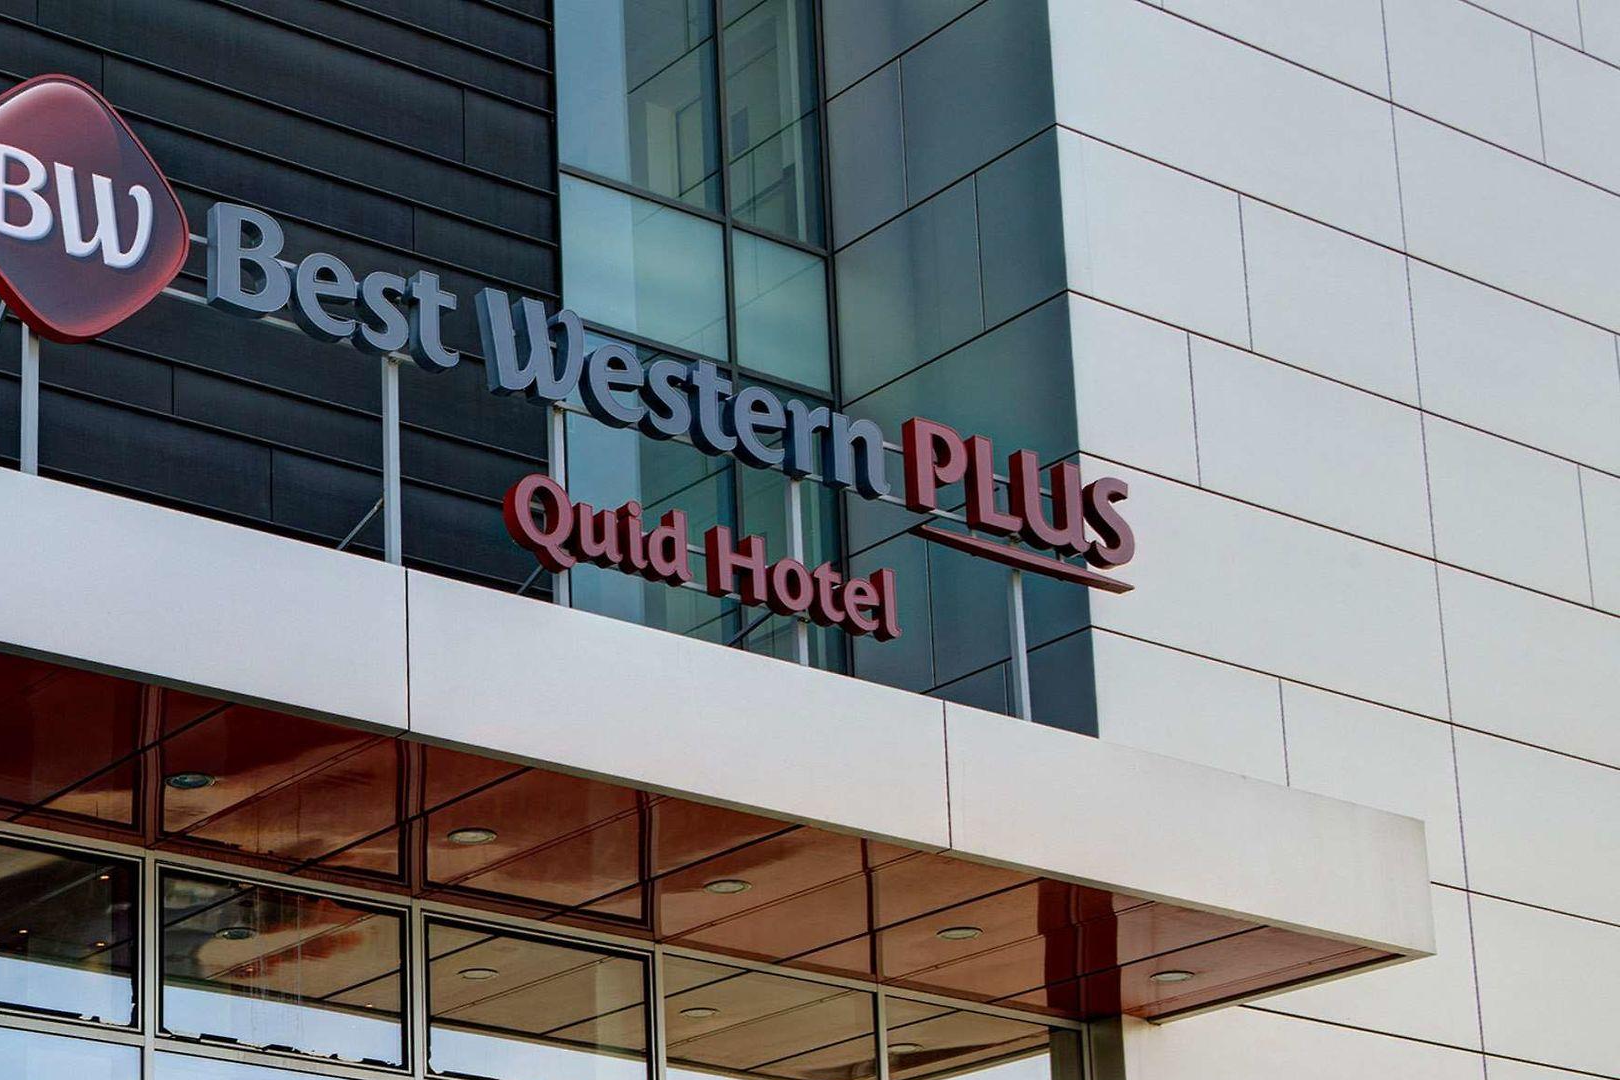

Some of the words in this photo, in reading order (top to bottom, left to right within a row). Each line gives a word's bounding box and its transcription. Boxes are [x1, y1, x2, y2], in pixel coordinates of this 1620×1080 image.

[206, 200, 460, 374] Best
[476, 286, 892, 500] Western
[903, 416, 1136, 570] PLUS
[503, 472, 693, 587] Quid
[705, 523, 902, 641] Hotel
